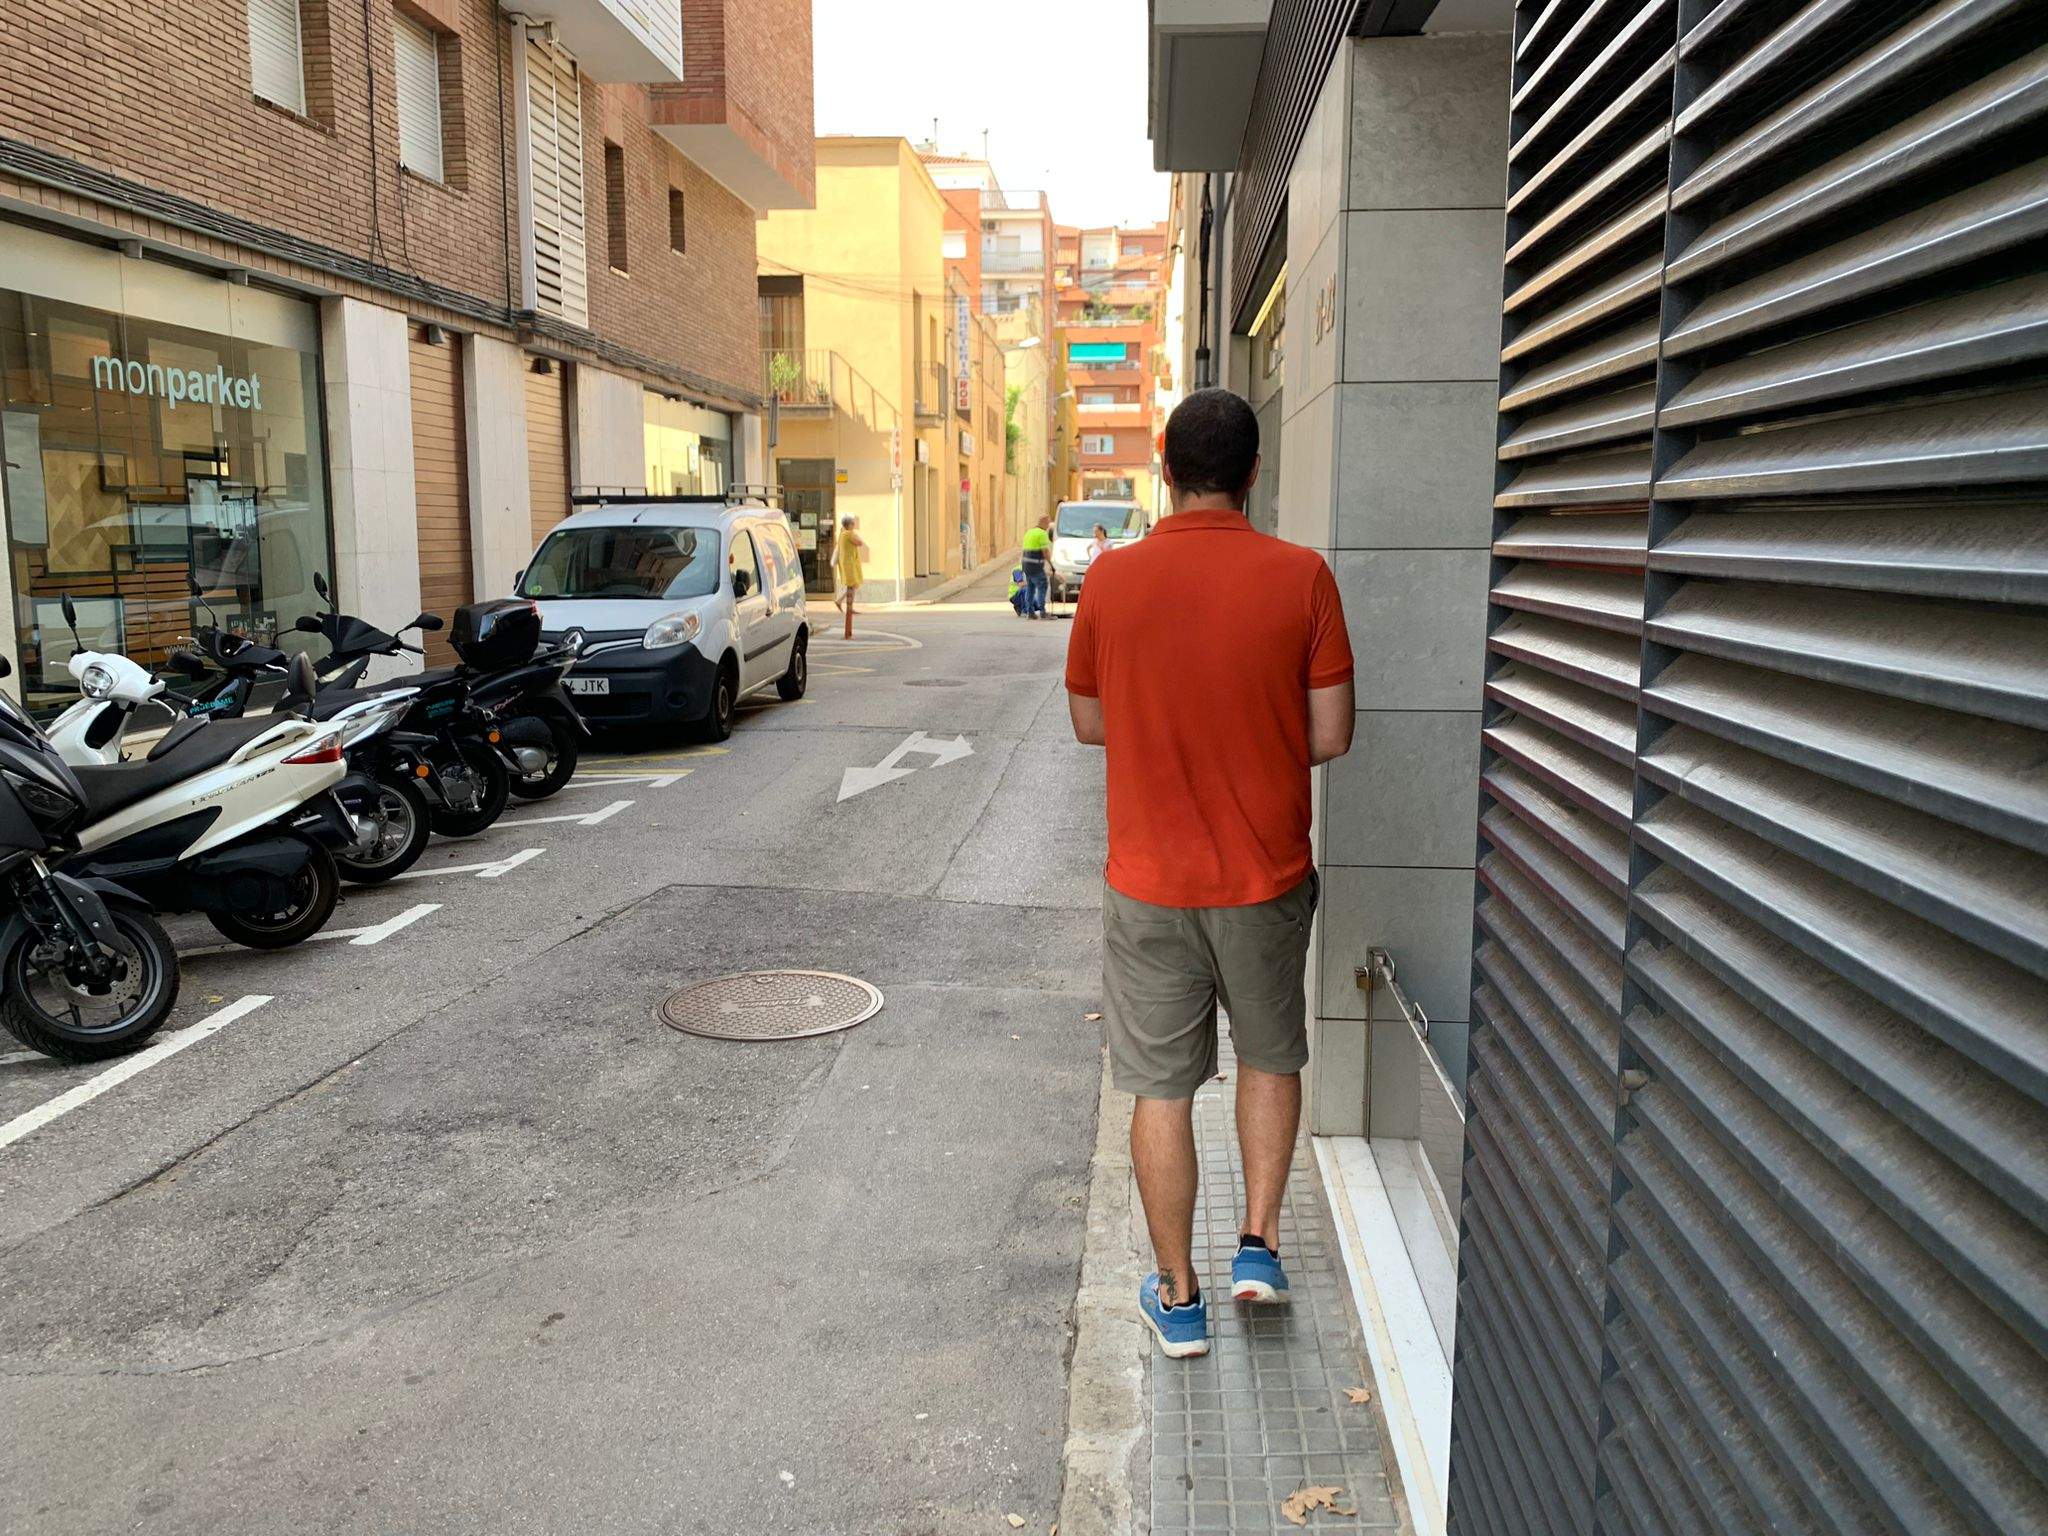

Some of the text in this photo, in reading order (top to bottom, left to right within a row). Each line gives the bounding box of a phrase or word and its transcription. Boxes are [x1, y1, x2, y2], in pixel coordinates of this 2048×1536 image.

[93, 355, 262, 410] monparket
[959, 381, 969, 407] ROS
[581, 680, 605, 692] JTK
